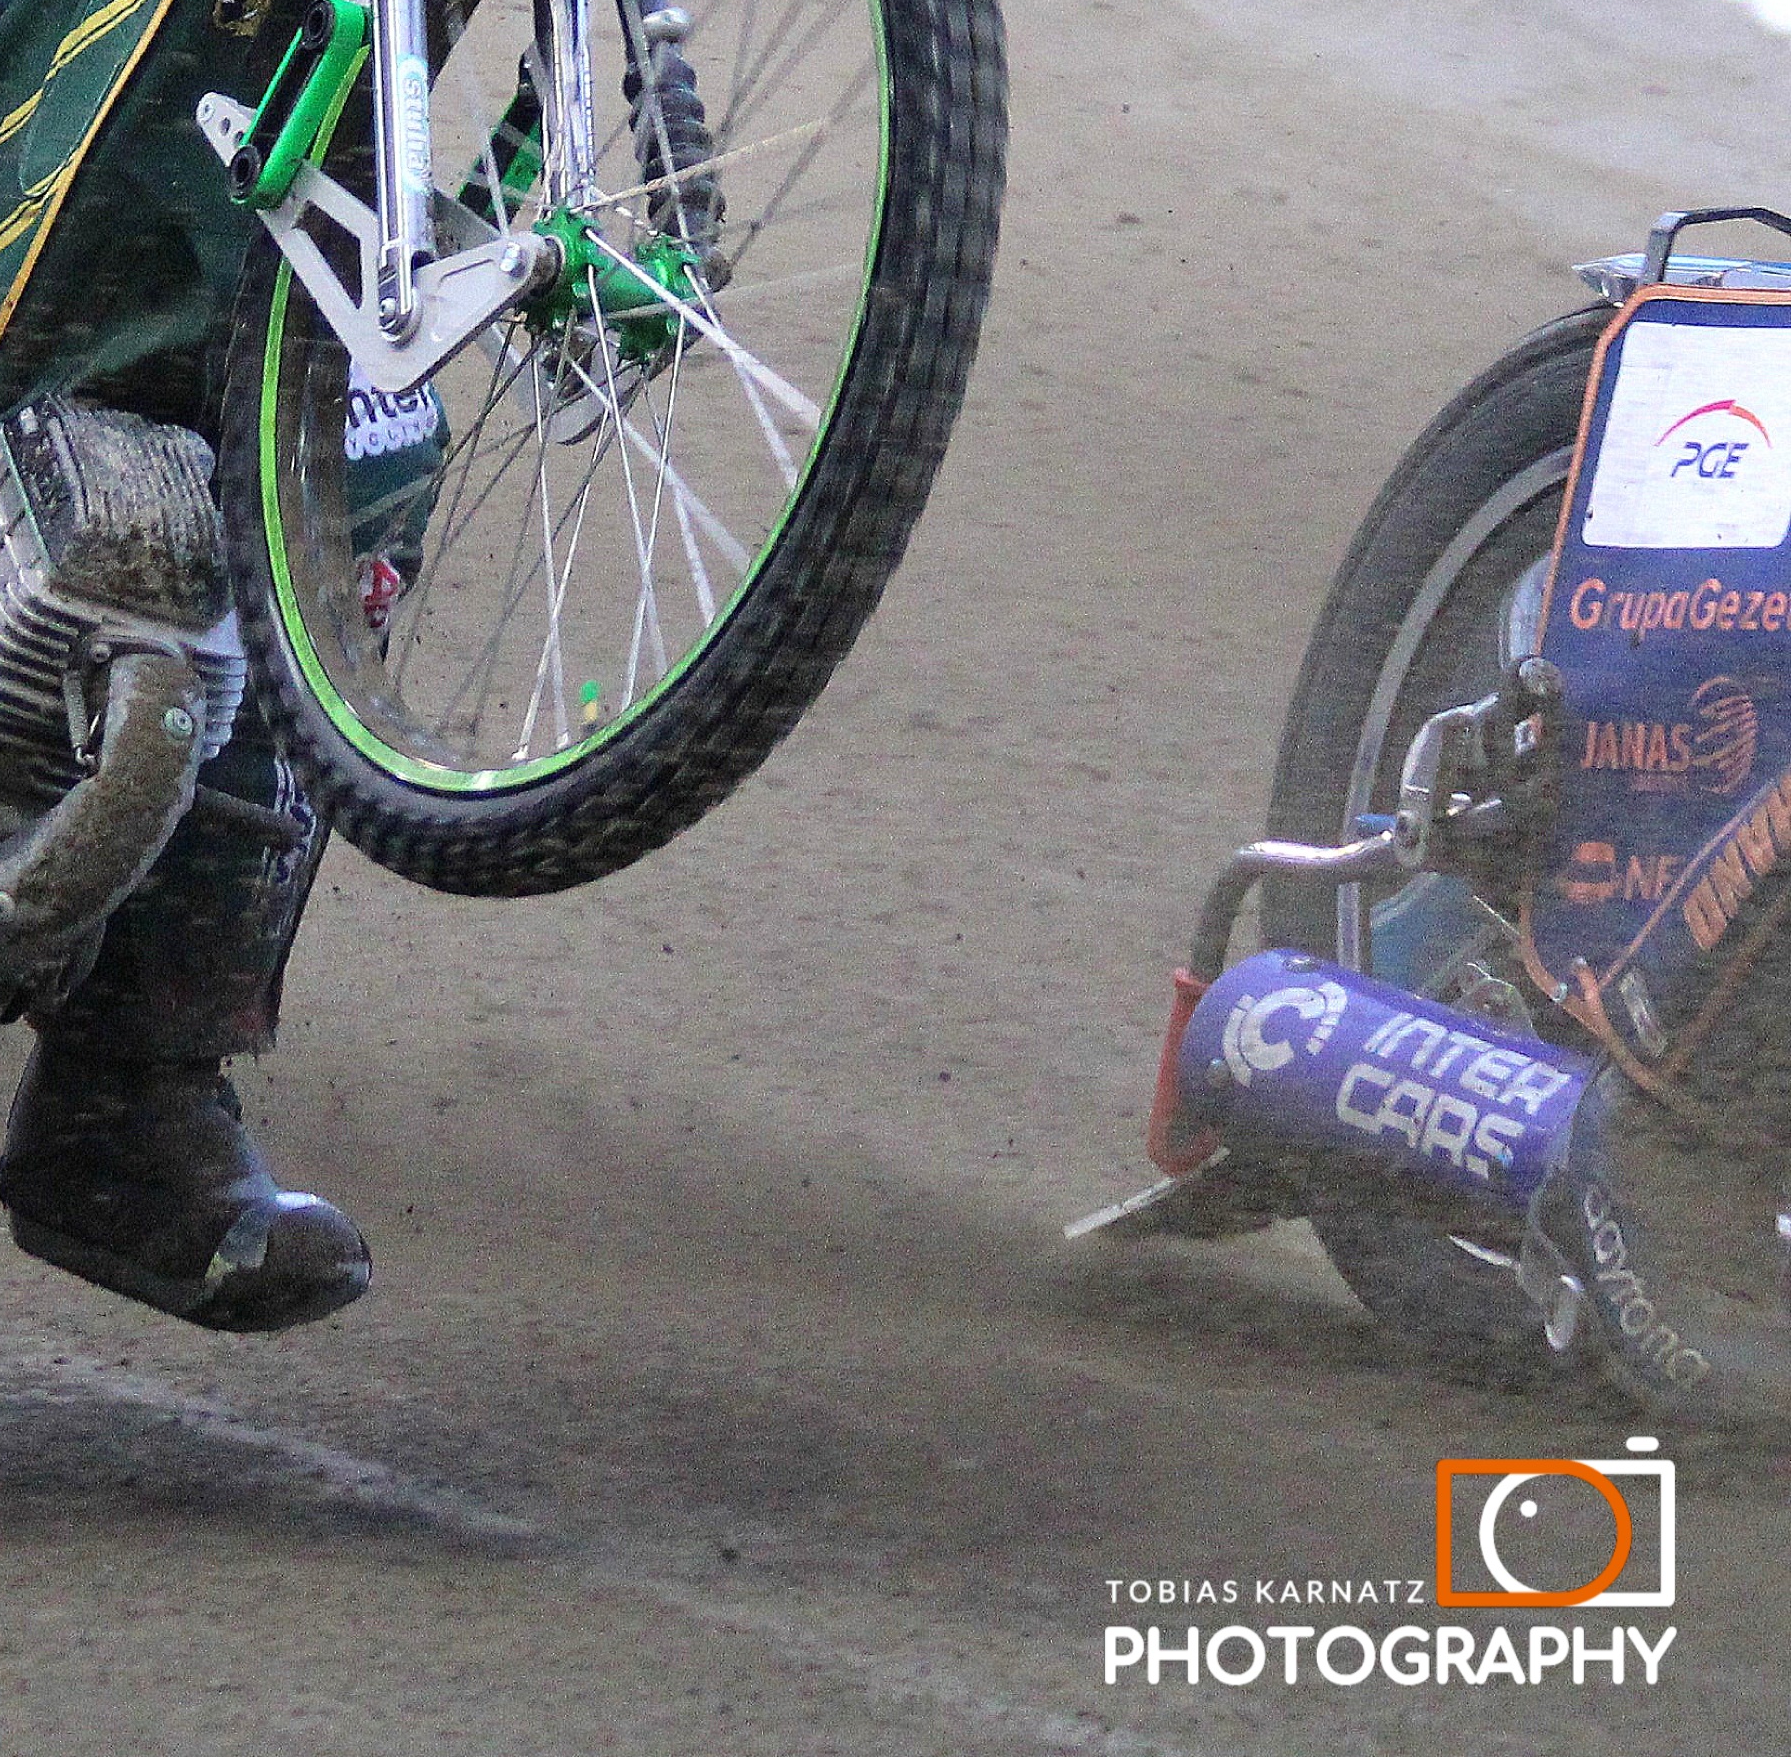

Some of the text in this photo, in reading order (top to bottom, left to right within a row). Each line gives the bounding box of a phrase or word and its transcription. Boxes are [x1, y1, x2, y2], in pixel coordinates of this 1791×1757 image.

[1670, 442, 1752, 479] PGE
[1569, 576, 1791, 641] GrupaGeze
[1579, 720, 1694, 774] JANAS
[1362, 1010, 1571, 1114] INTER
[1336, 1062, 1527, 1179] CARS
